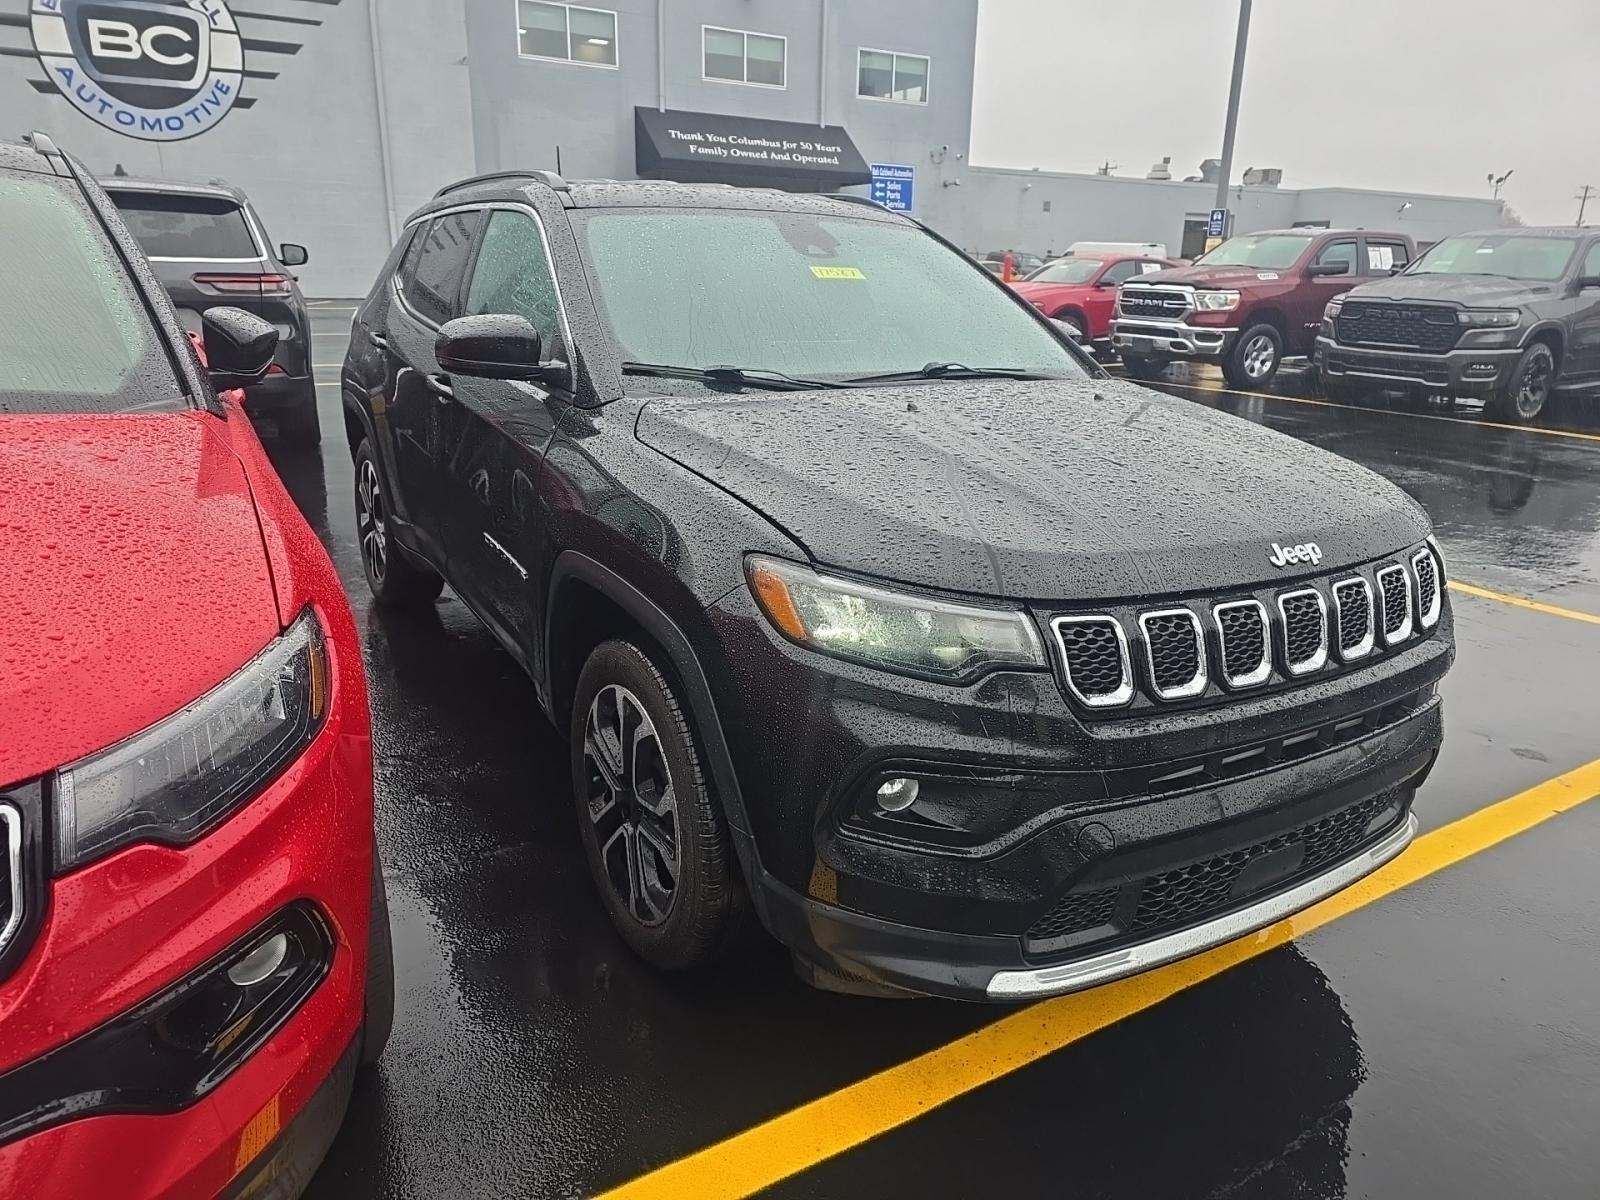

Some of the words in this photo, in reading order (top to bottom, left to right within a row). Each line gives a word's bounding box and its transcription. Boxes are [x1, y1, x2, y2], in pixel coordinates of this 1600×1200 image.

[87, 18, 195, 65] BC
[55, 66, 231, 132] AUTOMOTIVE
[668, 129, 704, 141] Thank
[706, 133, 727, 143] You
[728, 135, 781, 148] Columbus
[782, 140, 798, 150] for
[800, 141, 813, 151] 50
[814, 143, 842, 153] Years
[689, 144, 728, 158] Family
[730, 148, 768, 159] Owned
[770, 151, 791, 161] And
[792, 153, 840, 165] Operated
[886, 180, 902, 190] Sales
[886, 190, 901, 200] Parts
[886, 199, 906, 209] Service
[1133, 298, 1162, 307] RAM
[1364, 307, 1422, 320] RAM
[1269, 542, 1322, 567] Jeep
